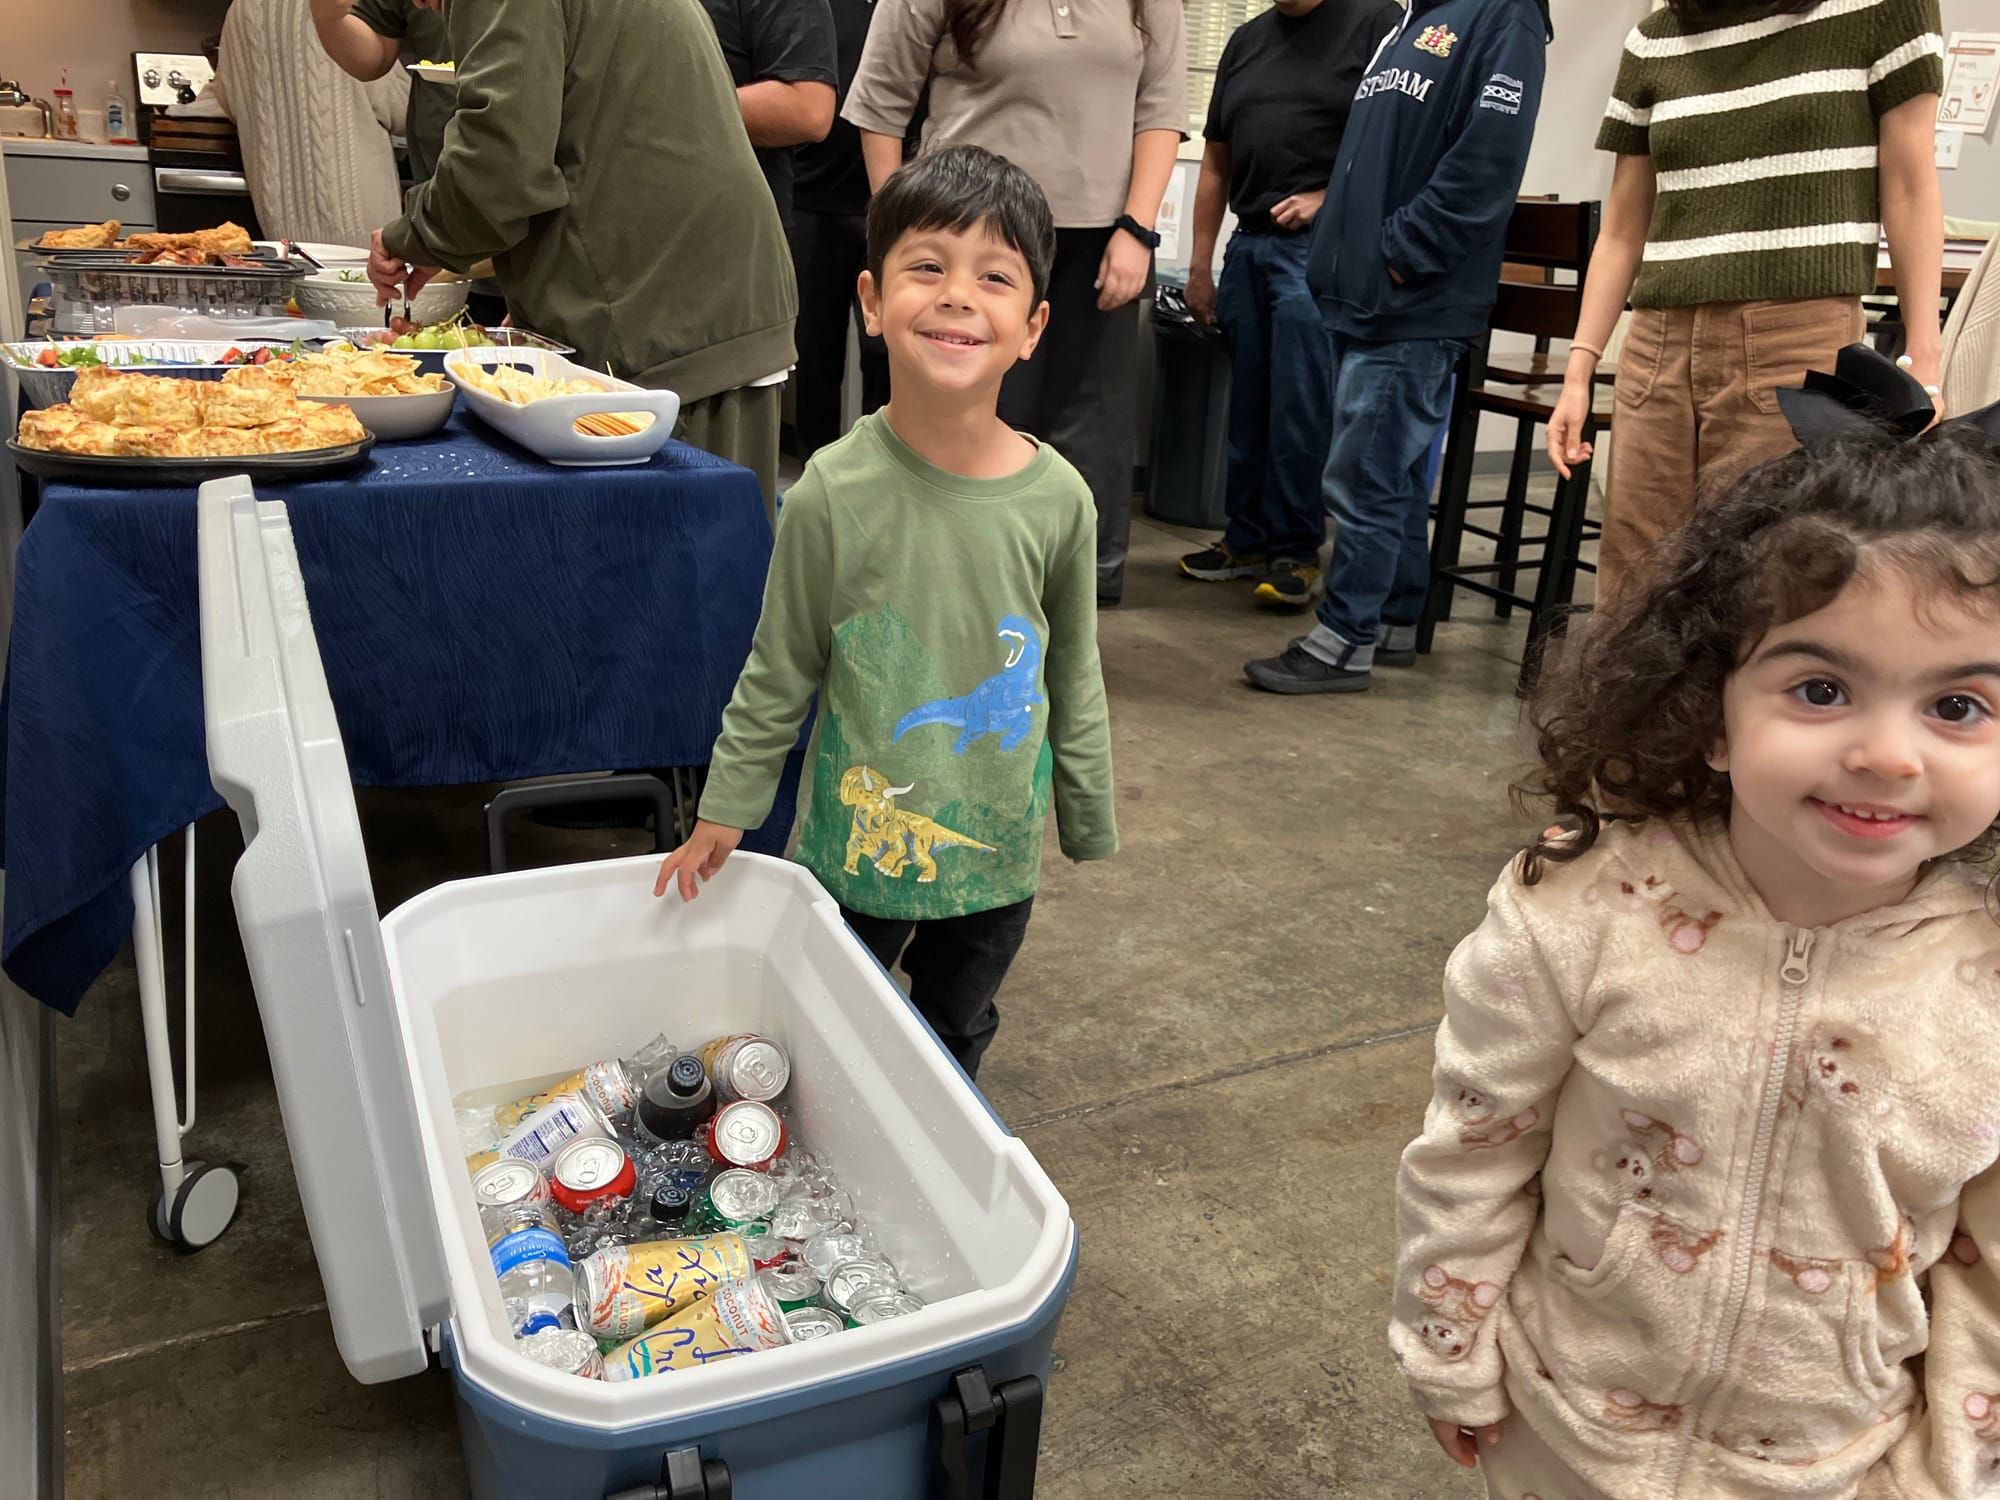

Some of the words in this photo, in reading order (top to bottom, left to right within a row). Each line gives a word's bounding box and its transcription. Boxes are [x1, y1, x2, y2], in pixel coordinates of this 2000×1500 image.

[1354, 68, 1434, 102] STDAM
[617, 1300, 630, 1342] CONUT
[722, 1288, 749, 1335] COCONUT
